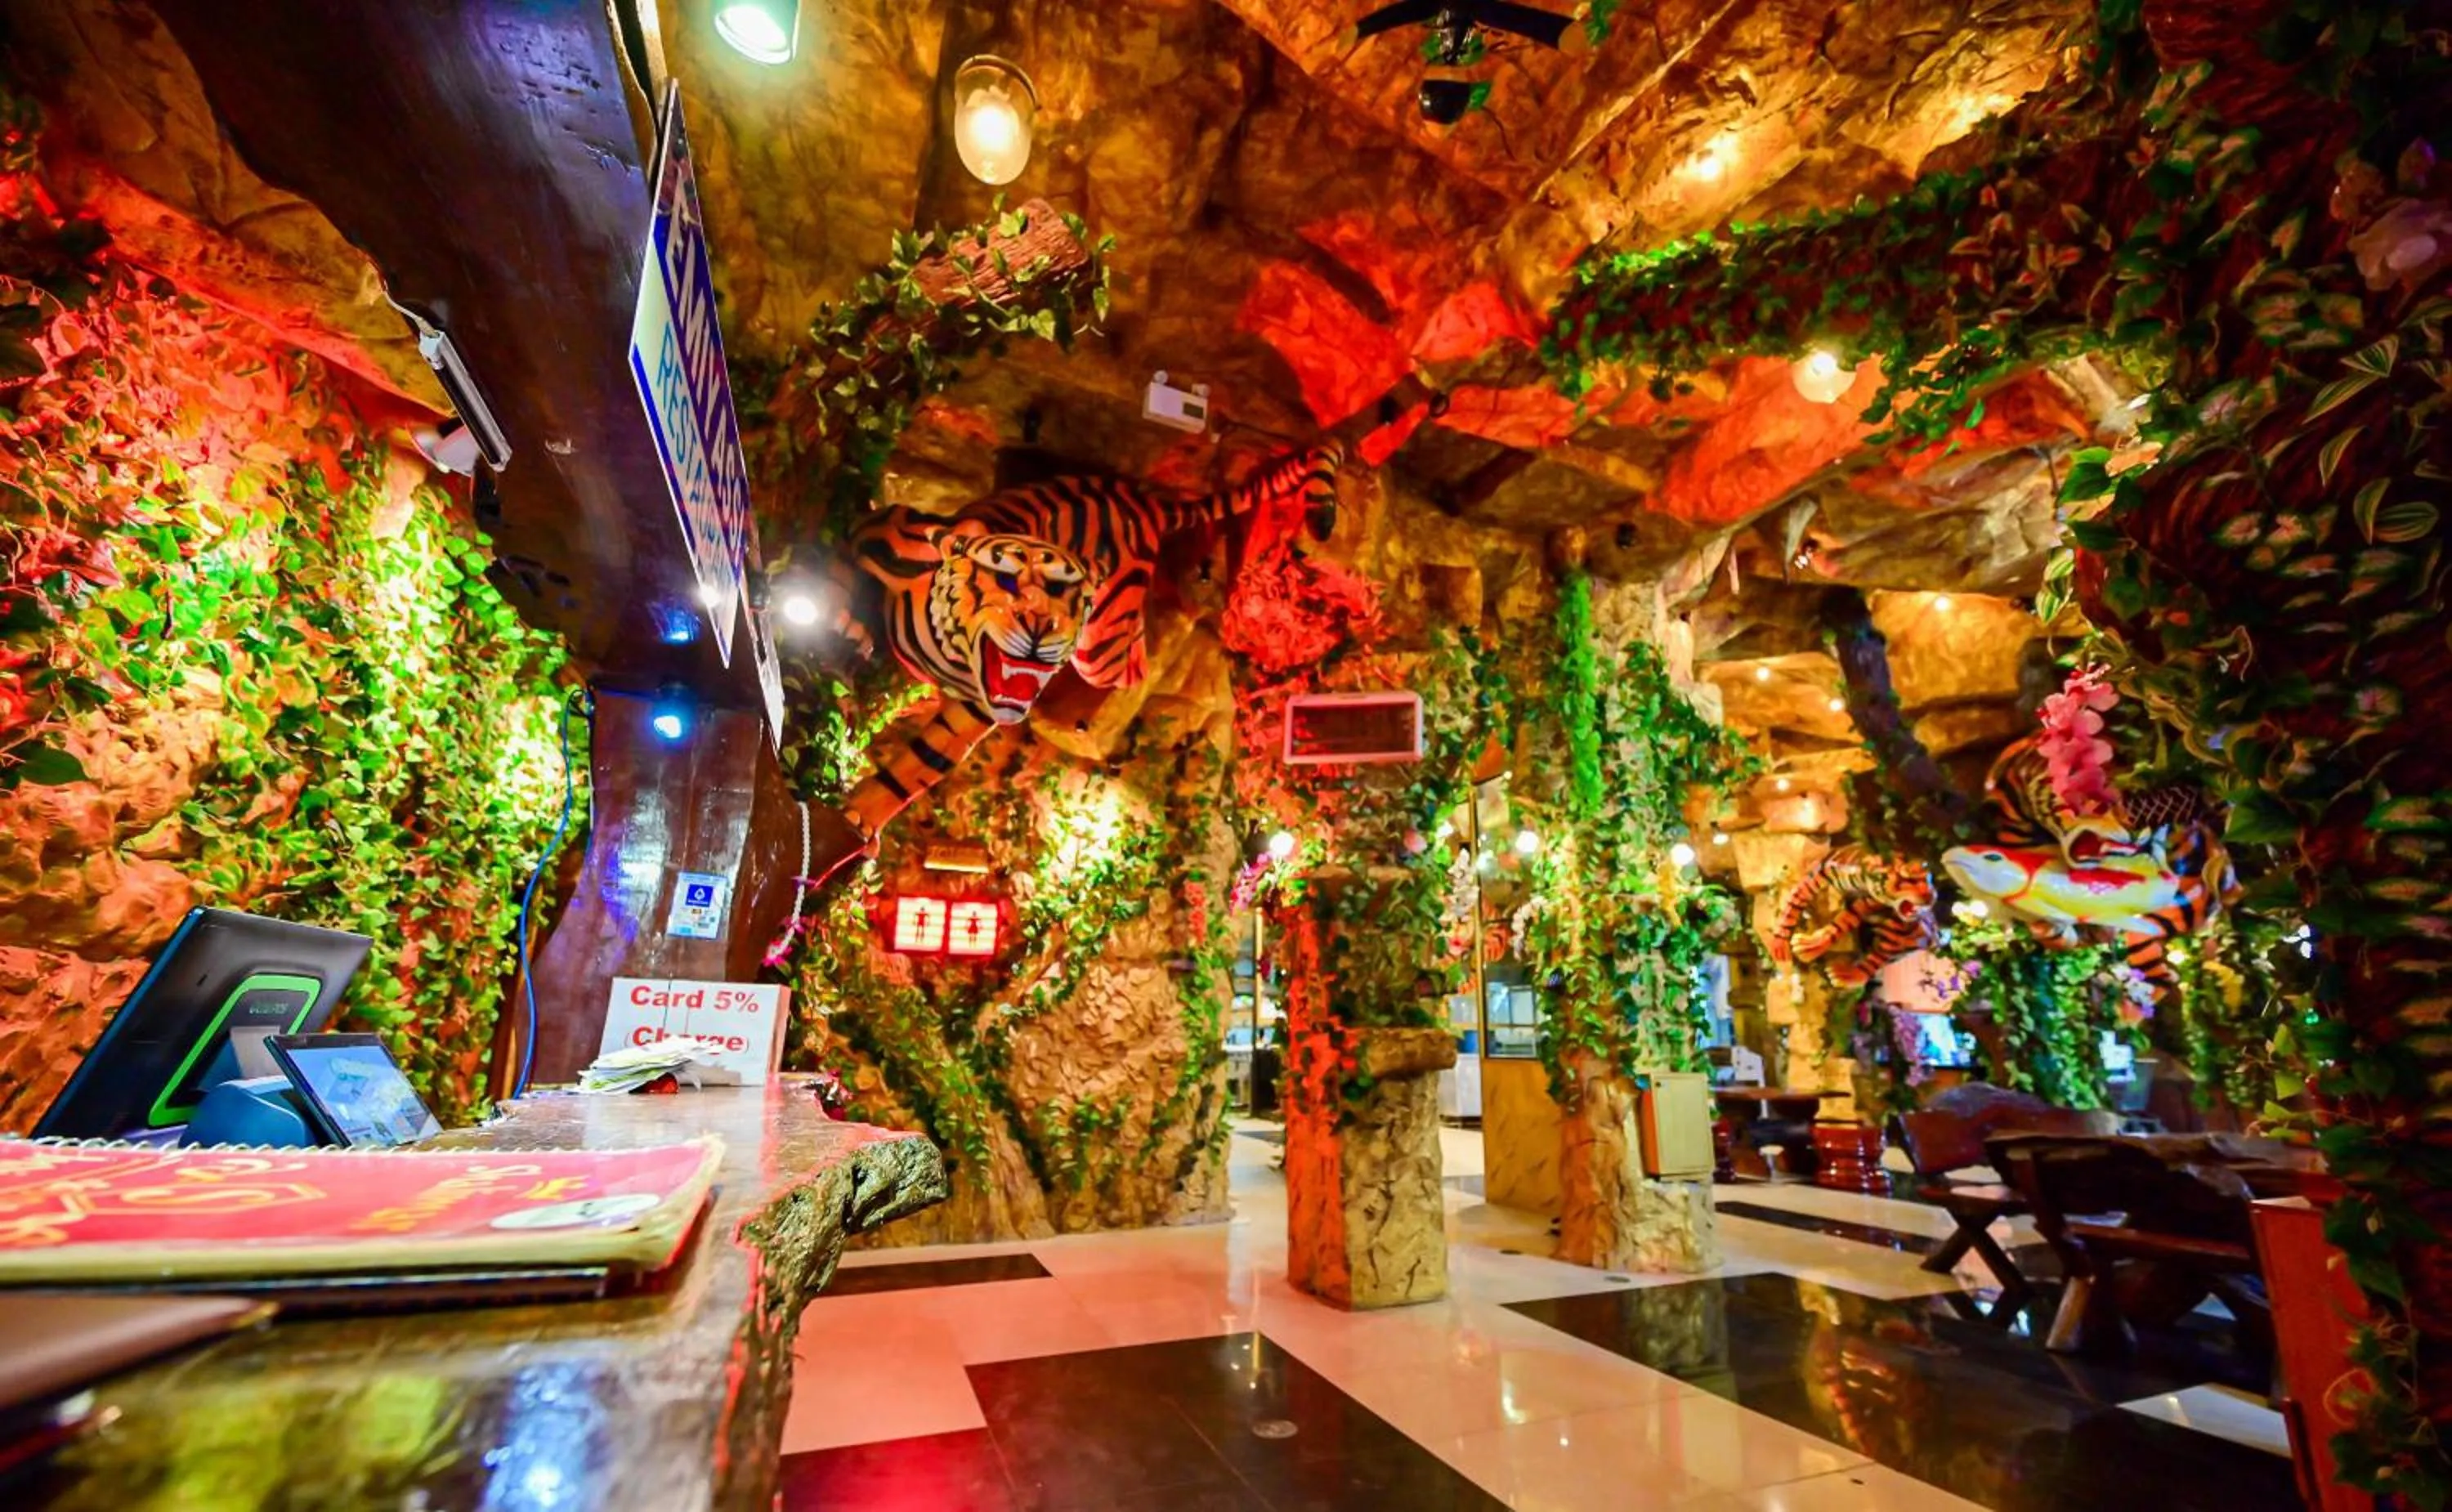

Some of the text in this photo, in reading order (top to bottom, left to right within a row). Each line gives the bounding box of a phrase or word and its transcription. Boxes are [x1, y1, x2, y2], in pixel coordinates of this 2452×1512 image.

[657, 321, 732, 590] RESTAURA
[630, 986, 759, 1013] Card 5%
